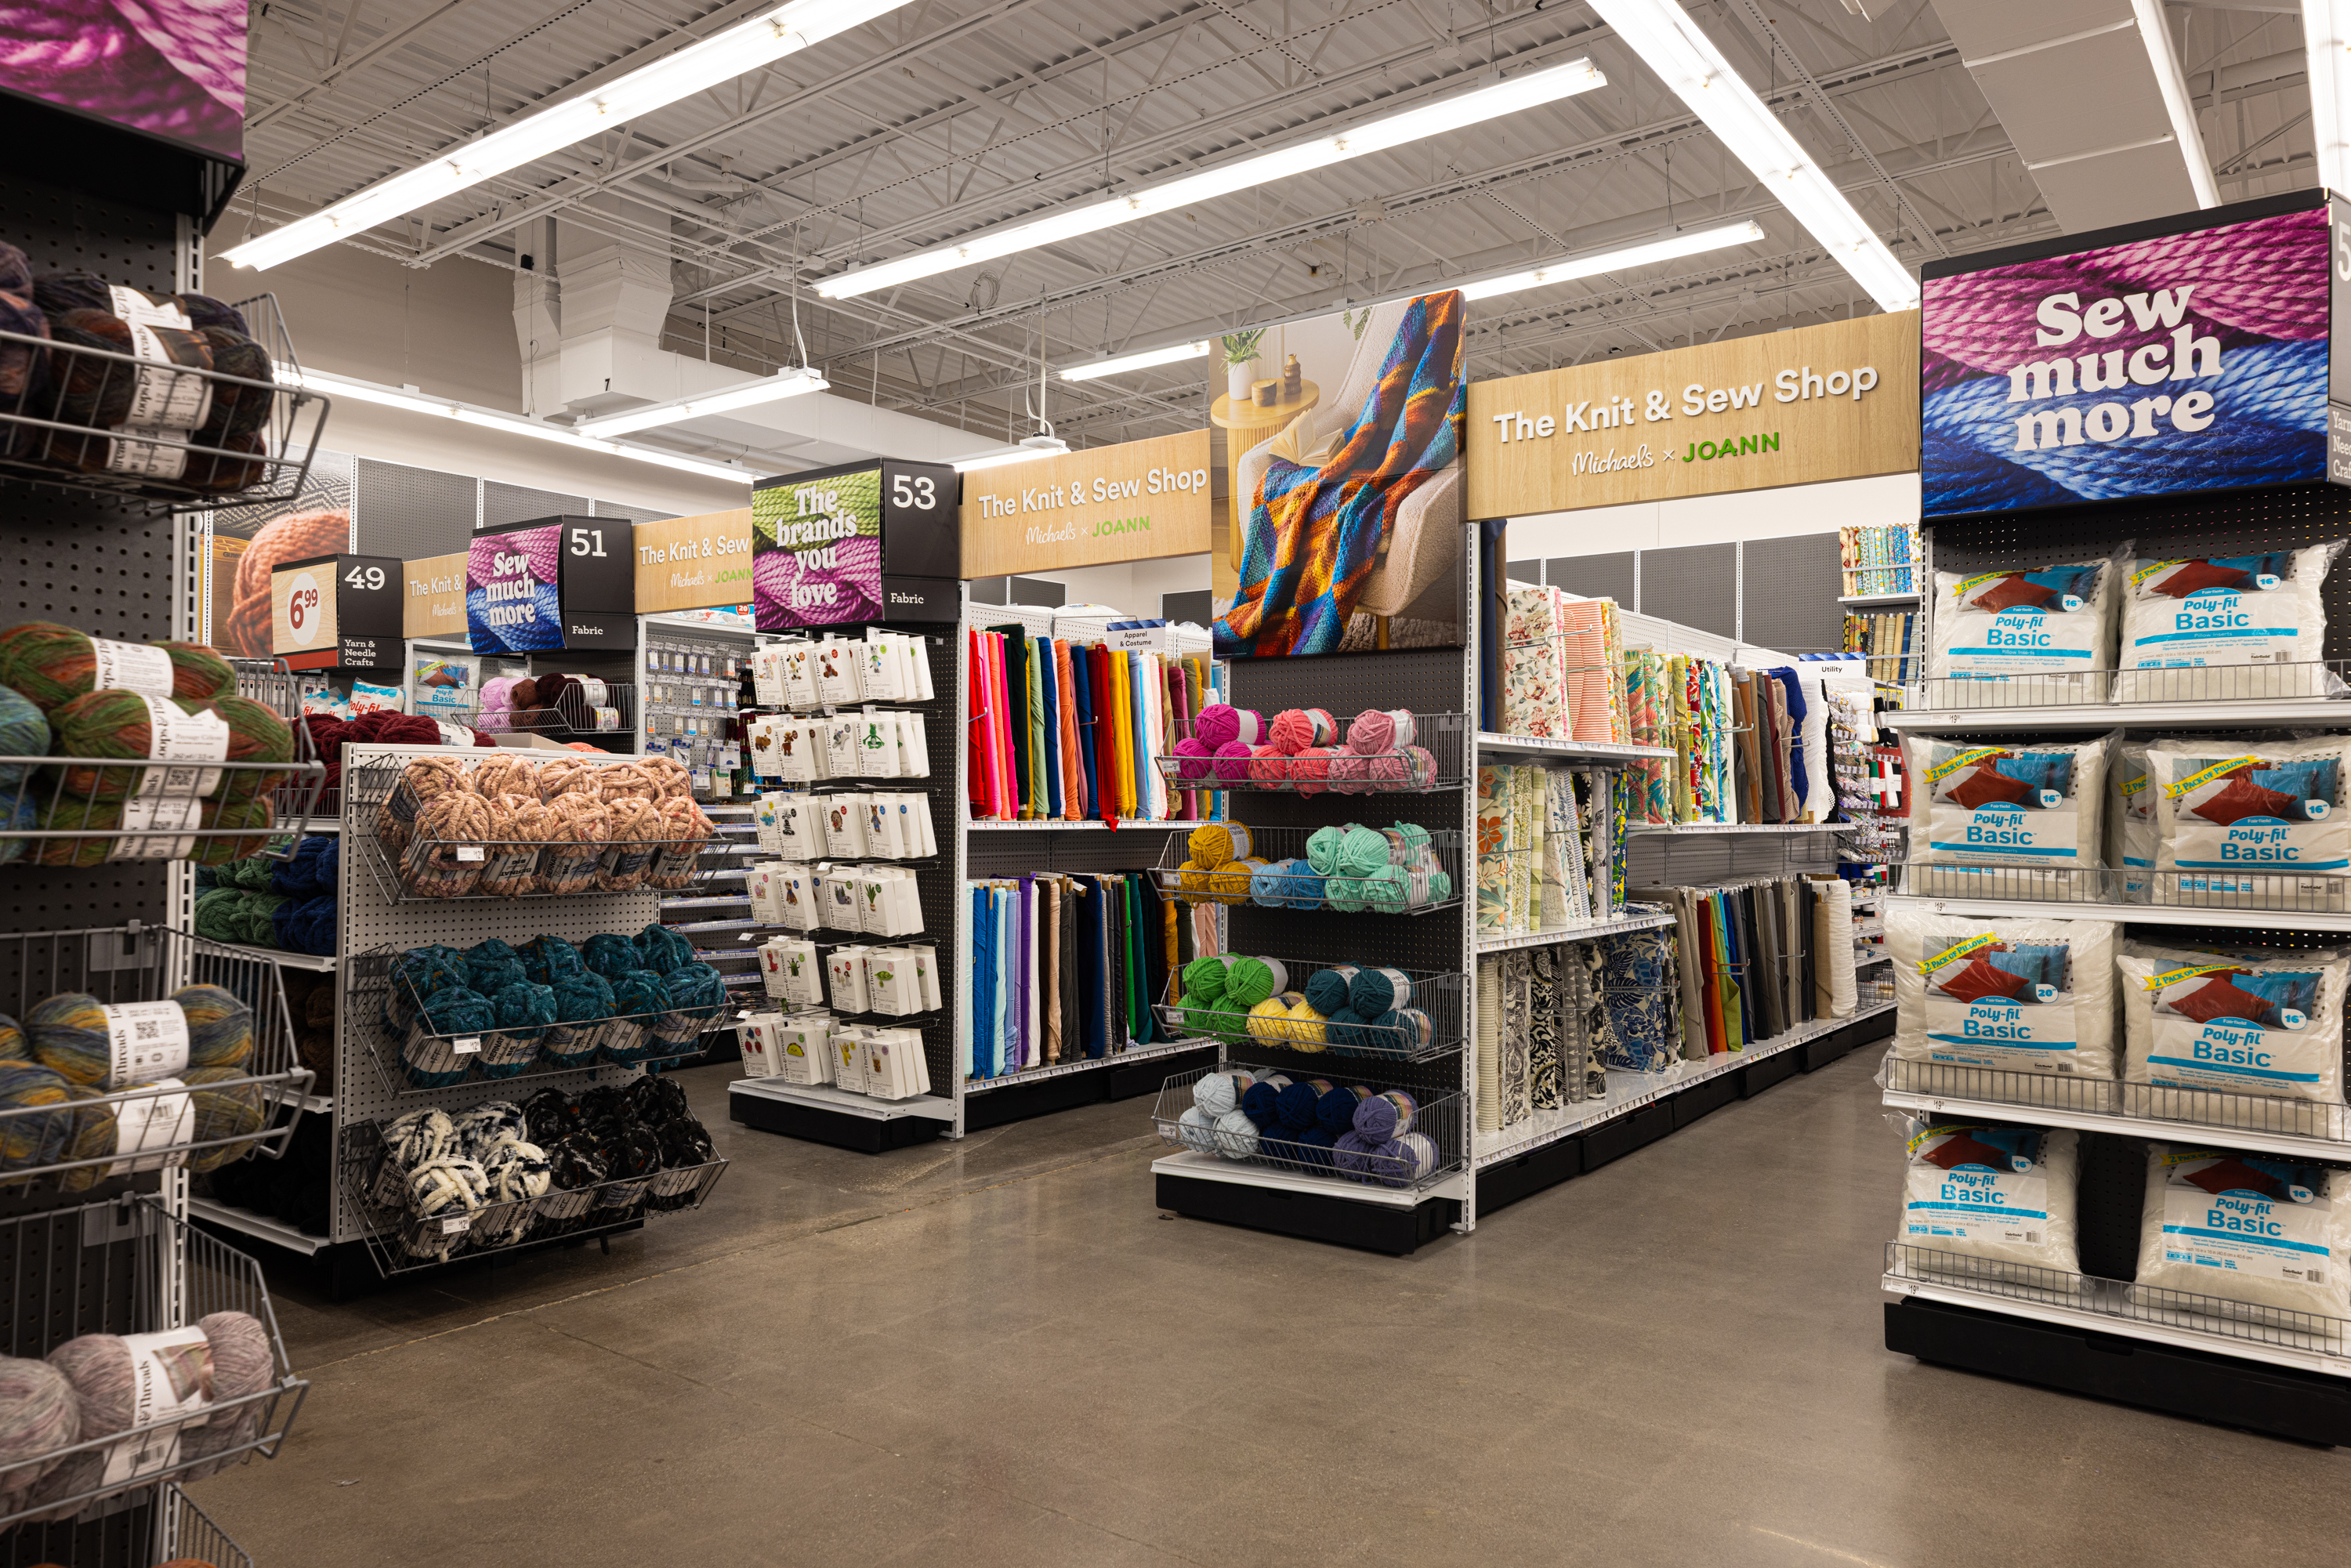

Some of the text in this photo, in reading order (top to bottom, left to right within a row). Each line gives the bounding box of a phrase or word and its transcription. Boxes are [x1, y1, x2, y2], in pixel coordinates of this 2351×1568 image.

[2338, 220, 2351, 282] 5
[2035, 284, 2195, 347] Sew
[2006, 323, 2225, 403] much
[133, 388, 152, 418] Loops
[1493, 365, 1879, 444] The Knit & Sew Shop
[2013, 391, 2215, 452] more
[1571, 444, 1654, 476] Michaels
[1682, 431, 1780, 463] JOANN
[794, 485, 838, 517] The
[892, 475, 936, 510] 53
[978, 466, 1208, 520] The Knit & Sew Shop
[776, 510, 857, 548] brands
[1025, 520, 1076, 546] Michaels
[1092, 515, 1151, 538] JOANN
[571, 528, 607, 557] 51
[639, 534, 749, 566] The Knit & Sew
[493, 552, 531, 577] Sew
[793, 546, 837, 580] you
[345, 566, 385, 590] 49
[410, 574, 462, 596] The Knit &
[486, 572, 535, 603] much
[671, 567, 753, 588] Michaels JOANN
[790, 580, 838, 608] love
[890, 592, 924, 605] Fabric
[2183, 597, 2238, 613] Poly-fil
[433, 603, 457, 617] Michaels
[489, 602, 535, 626] more
[2175, 610, 2250, 630] Basic
[572, 625, 603, 635] Fabric
[1995, 617, 2044, 629] Poly-fil
[345, 639, 366, 648] Yarn
[1124, 631, 1148, 642] Apparel
[1127, 639, 1152, 647] Costume
[1987, 629, 2051, 646] Basic
[345, 657, 374, 666] Crafts
[432, 694, 456, 703] Basic
[1931, 770, 1938, 779] 2
[1939, 763, 1957, 776] PACK
[1956, 759, 1965, 767] OF
[2173, 757, 2249, 794] 2 PACK OF PILLOWS
[2125, 784, 2132, 793] 2
[1973, 813, 2023, 827] Poly-fil
[1967, 827, 2033, 846] Basic
[2228, 827, 2287, 843] Poly-fil
[2220, 843, 2300, 861] Basic
[1925, 936, 1988, 971] 2 PACK OF PILLOWS
[2154, 977, 2161, 987] 2
[2163, 972, 2183, 984] PACK
[1969, 1008, 2020, 1022] Poly-fil
[1963, 1019, 2031, 1040] Basic
[2202, 1027, 2261, 1046] Poly-fil
[114, 1030, 128, 1074] Threads
[487, 1036, 505, 1062] BERNAT
[2193, 1041, 2271, 1067] Basic
[1912, 1139, 1918, 1147] 2
[1948, 1173, 1995, 1187] Poly-fil
[1941, 1184, 2005, 1204] Basic
[2215, 1198, 2272, 1215] Poly-fil
[2207, 1209, 2282, 1237] Basic
[139, 1360, 152, 1410] Threads
